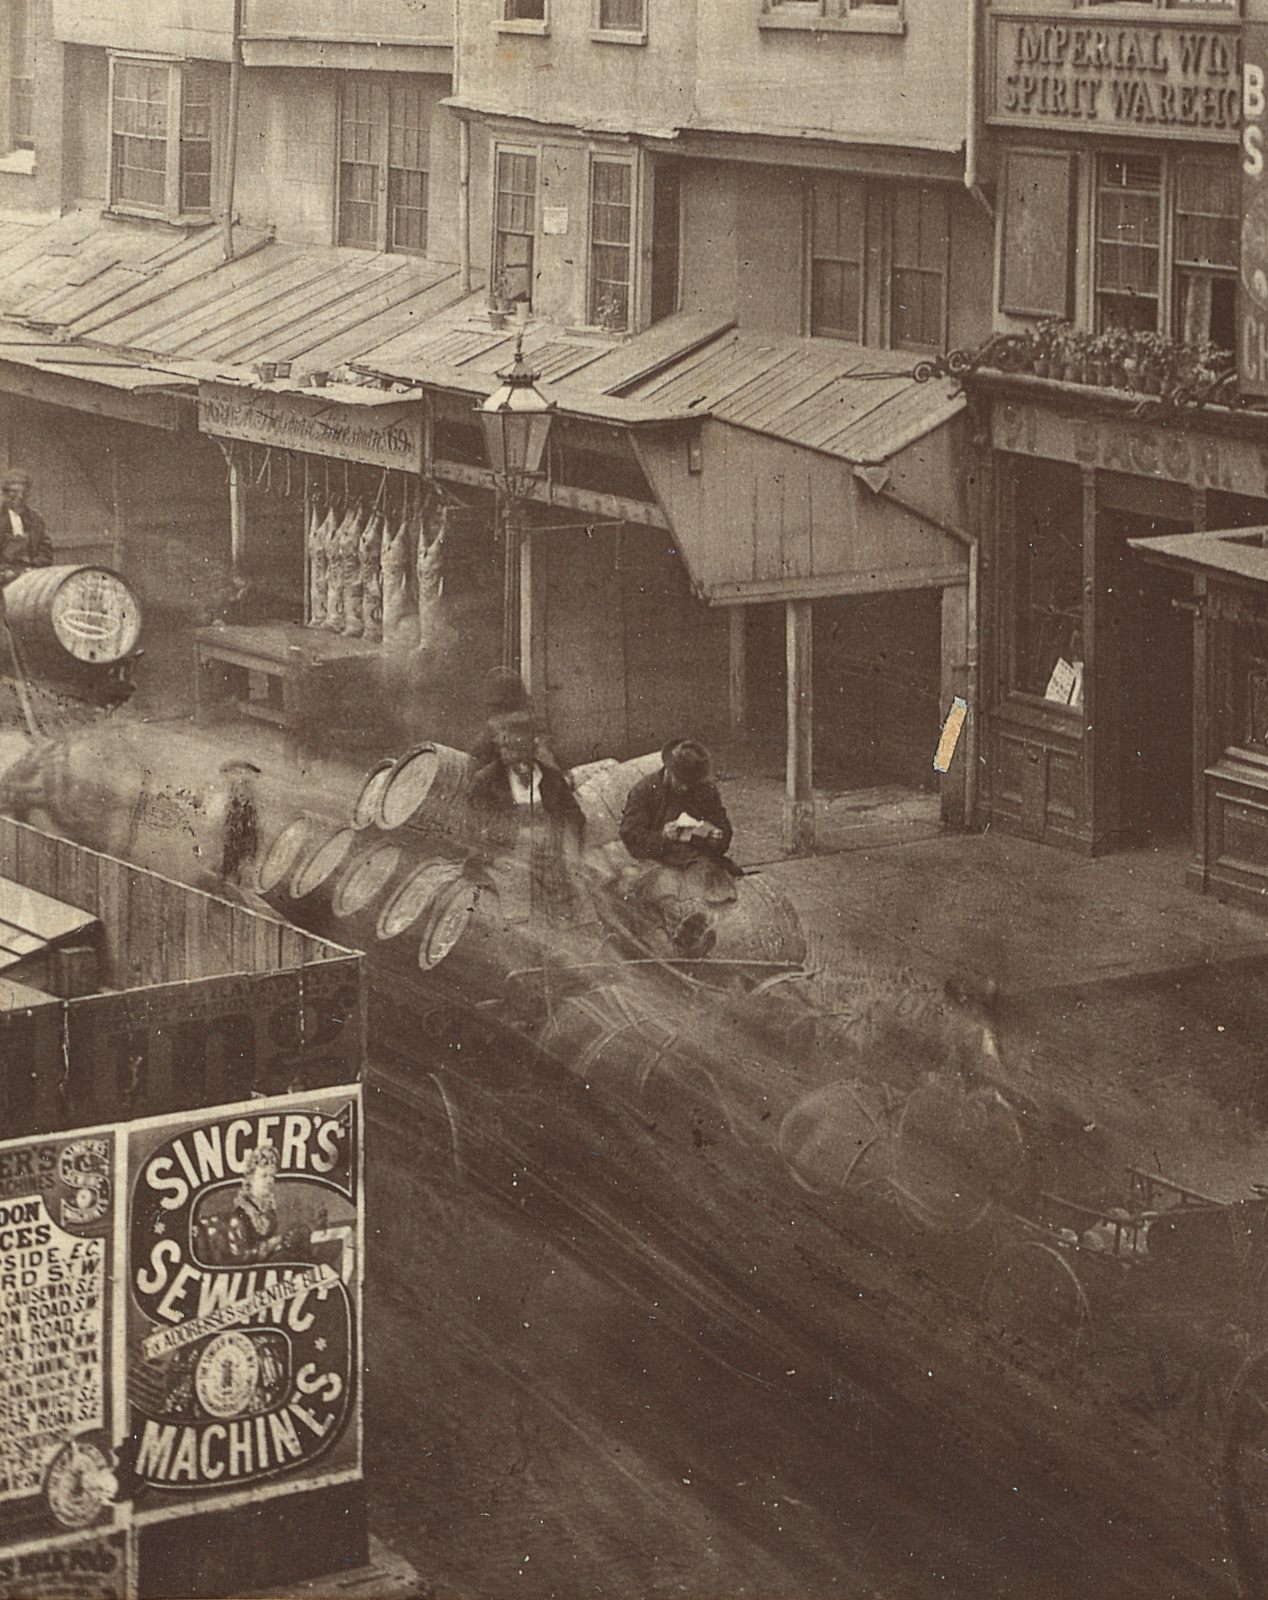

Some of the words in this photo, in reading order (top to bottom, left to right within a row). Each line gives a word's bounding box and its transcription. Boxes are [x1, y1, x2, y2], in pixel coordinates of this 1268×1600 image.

[1004, 75, 1102, 119] SPIRIT
[1013, 27, 1169, 74] IMPERIAL
[146, 1114, 346, 1211] SINGER'S
[136, 1238, 330, 1333] SEWING
[134, 1361, 342, 1481] MACHINES
